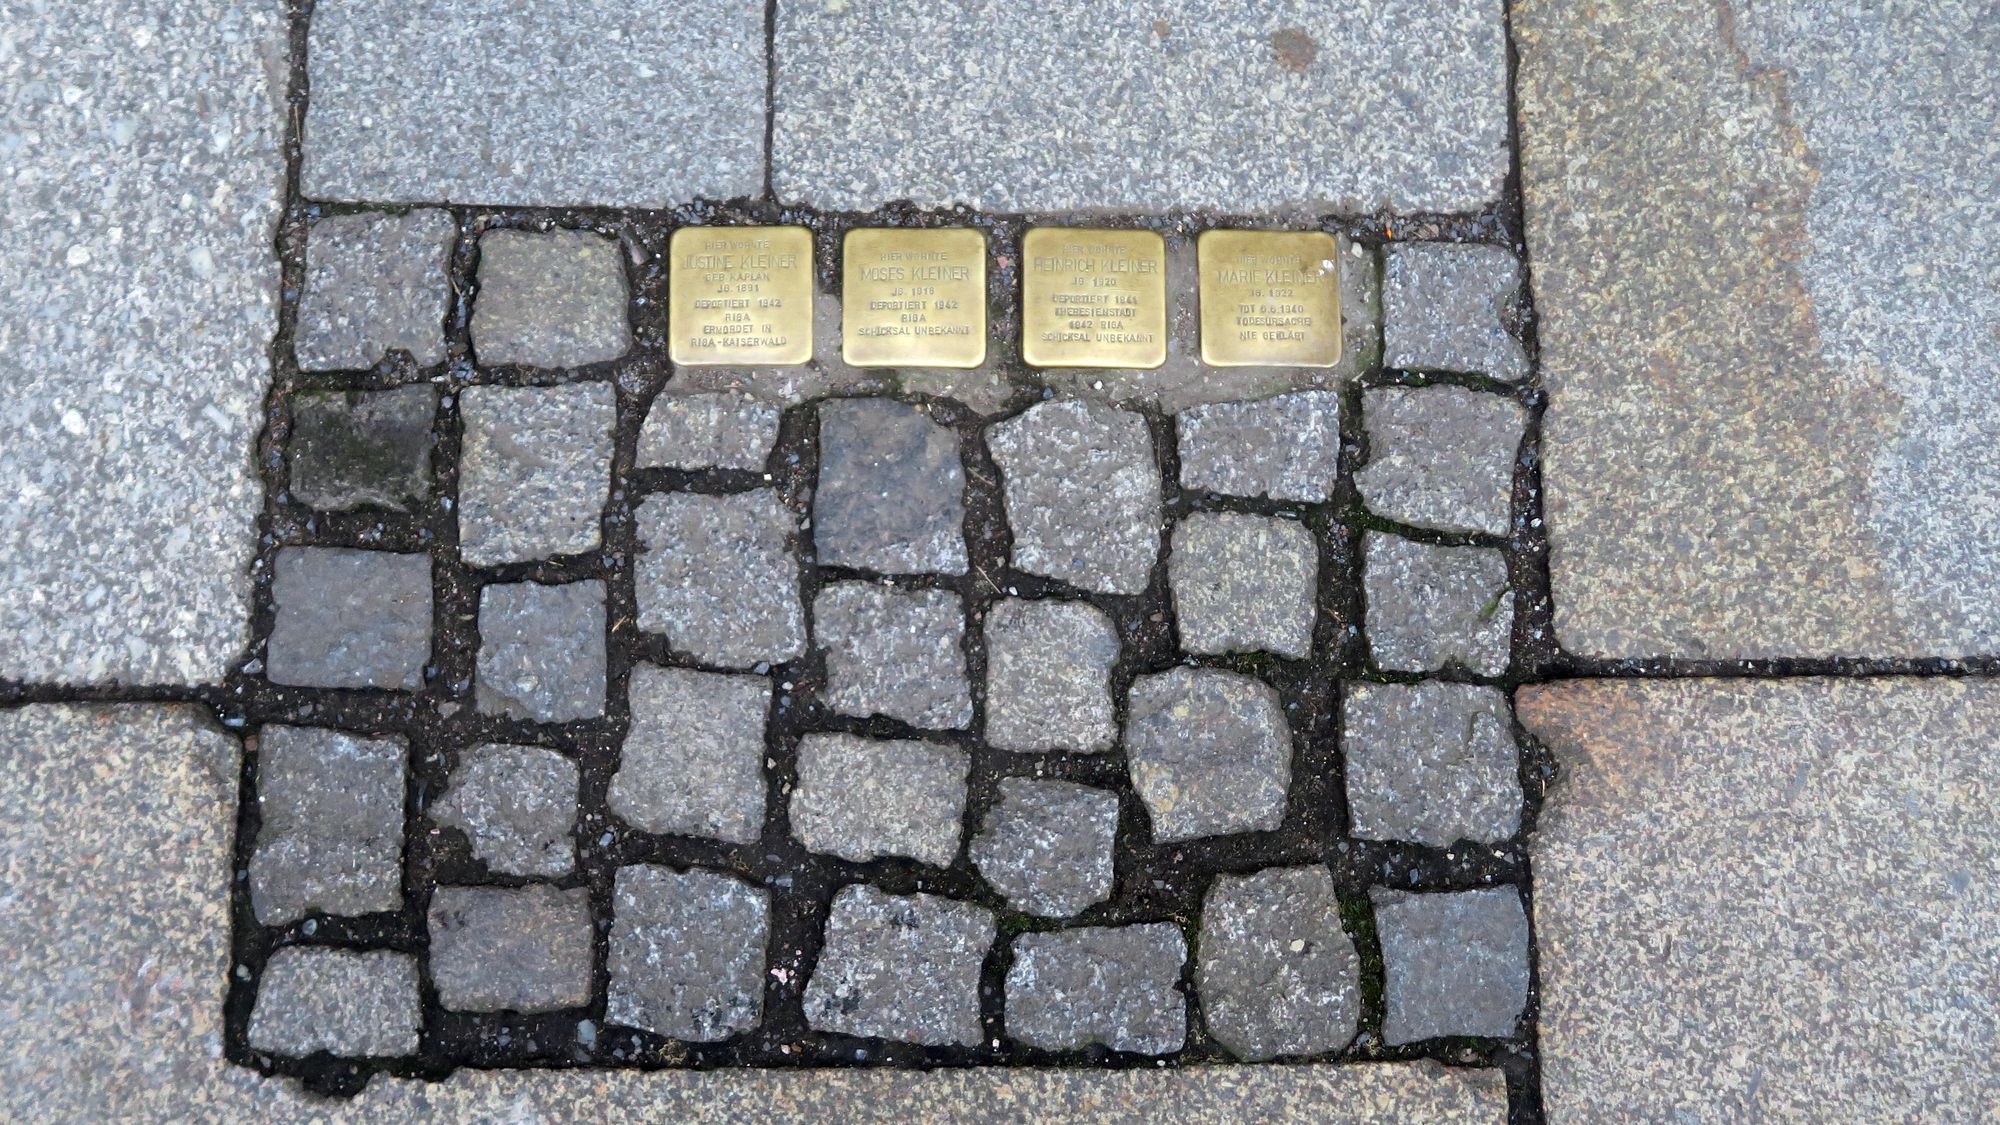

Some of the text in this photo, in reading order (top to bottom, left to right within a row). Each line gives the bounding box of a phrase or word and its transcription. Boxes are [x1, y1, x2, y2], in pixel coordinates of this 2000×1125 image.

[682, 254, 798, 270] JUSTINE KLEINER
[1033, 258, 1158, 273] HEINRICH KLEINER
[729, 273, 770, 282] KAPLAN
[859, 265, 970, 282] MOSES KLEINER
[1217, 269, 1325, 286] MARIE KLEINER
[736, 284, 760, 293] 1891
[694, 299, 782, 309] DEPORTIERT 1942
[870, 300, 959, 310] DEPORTIERT 1942
[1052, 295, 1109, 305] DEPORTIERT
[1055, 308, 1137, 317] THERESIENSTADT
[1238, 304, 1255, 314] TOT
[725, 313, 751, 322] RIGA
[901, 314, 927, 323] RIGA
[1236, 317, 1312, 327] TODESURSACHE
[703, 324, 772, 334] ERMORDET IN
[1100, 320, 1124, 330] RIGA
[858, 326, 970, 337] SCHICKSAL UNBEKANNT
[1240, 330, 1257, 341] NIE
[690, 337, 787, 347] RIGA-KAISERWALD
[1041, 332, 1153, 343] SCHICKSAL UNBEKANNT
